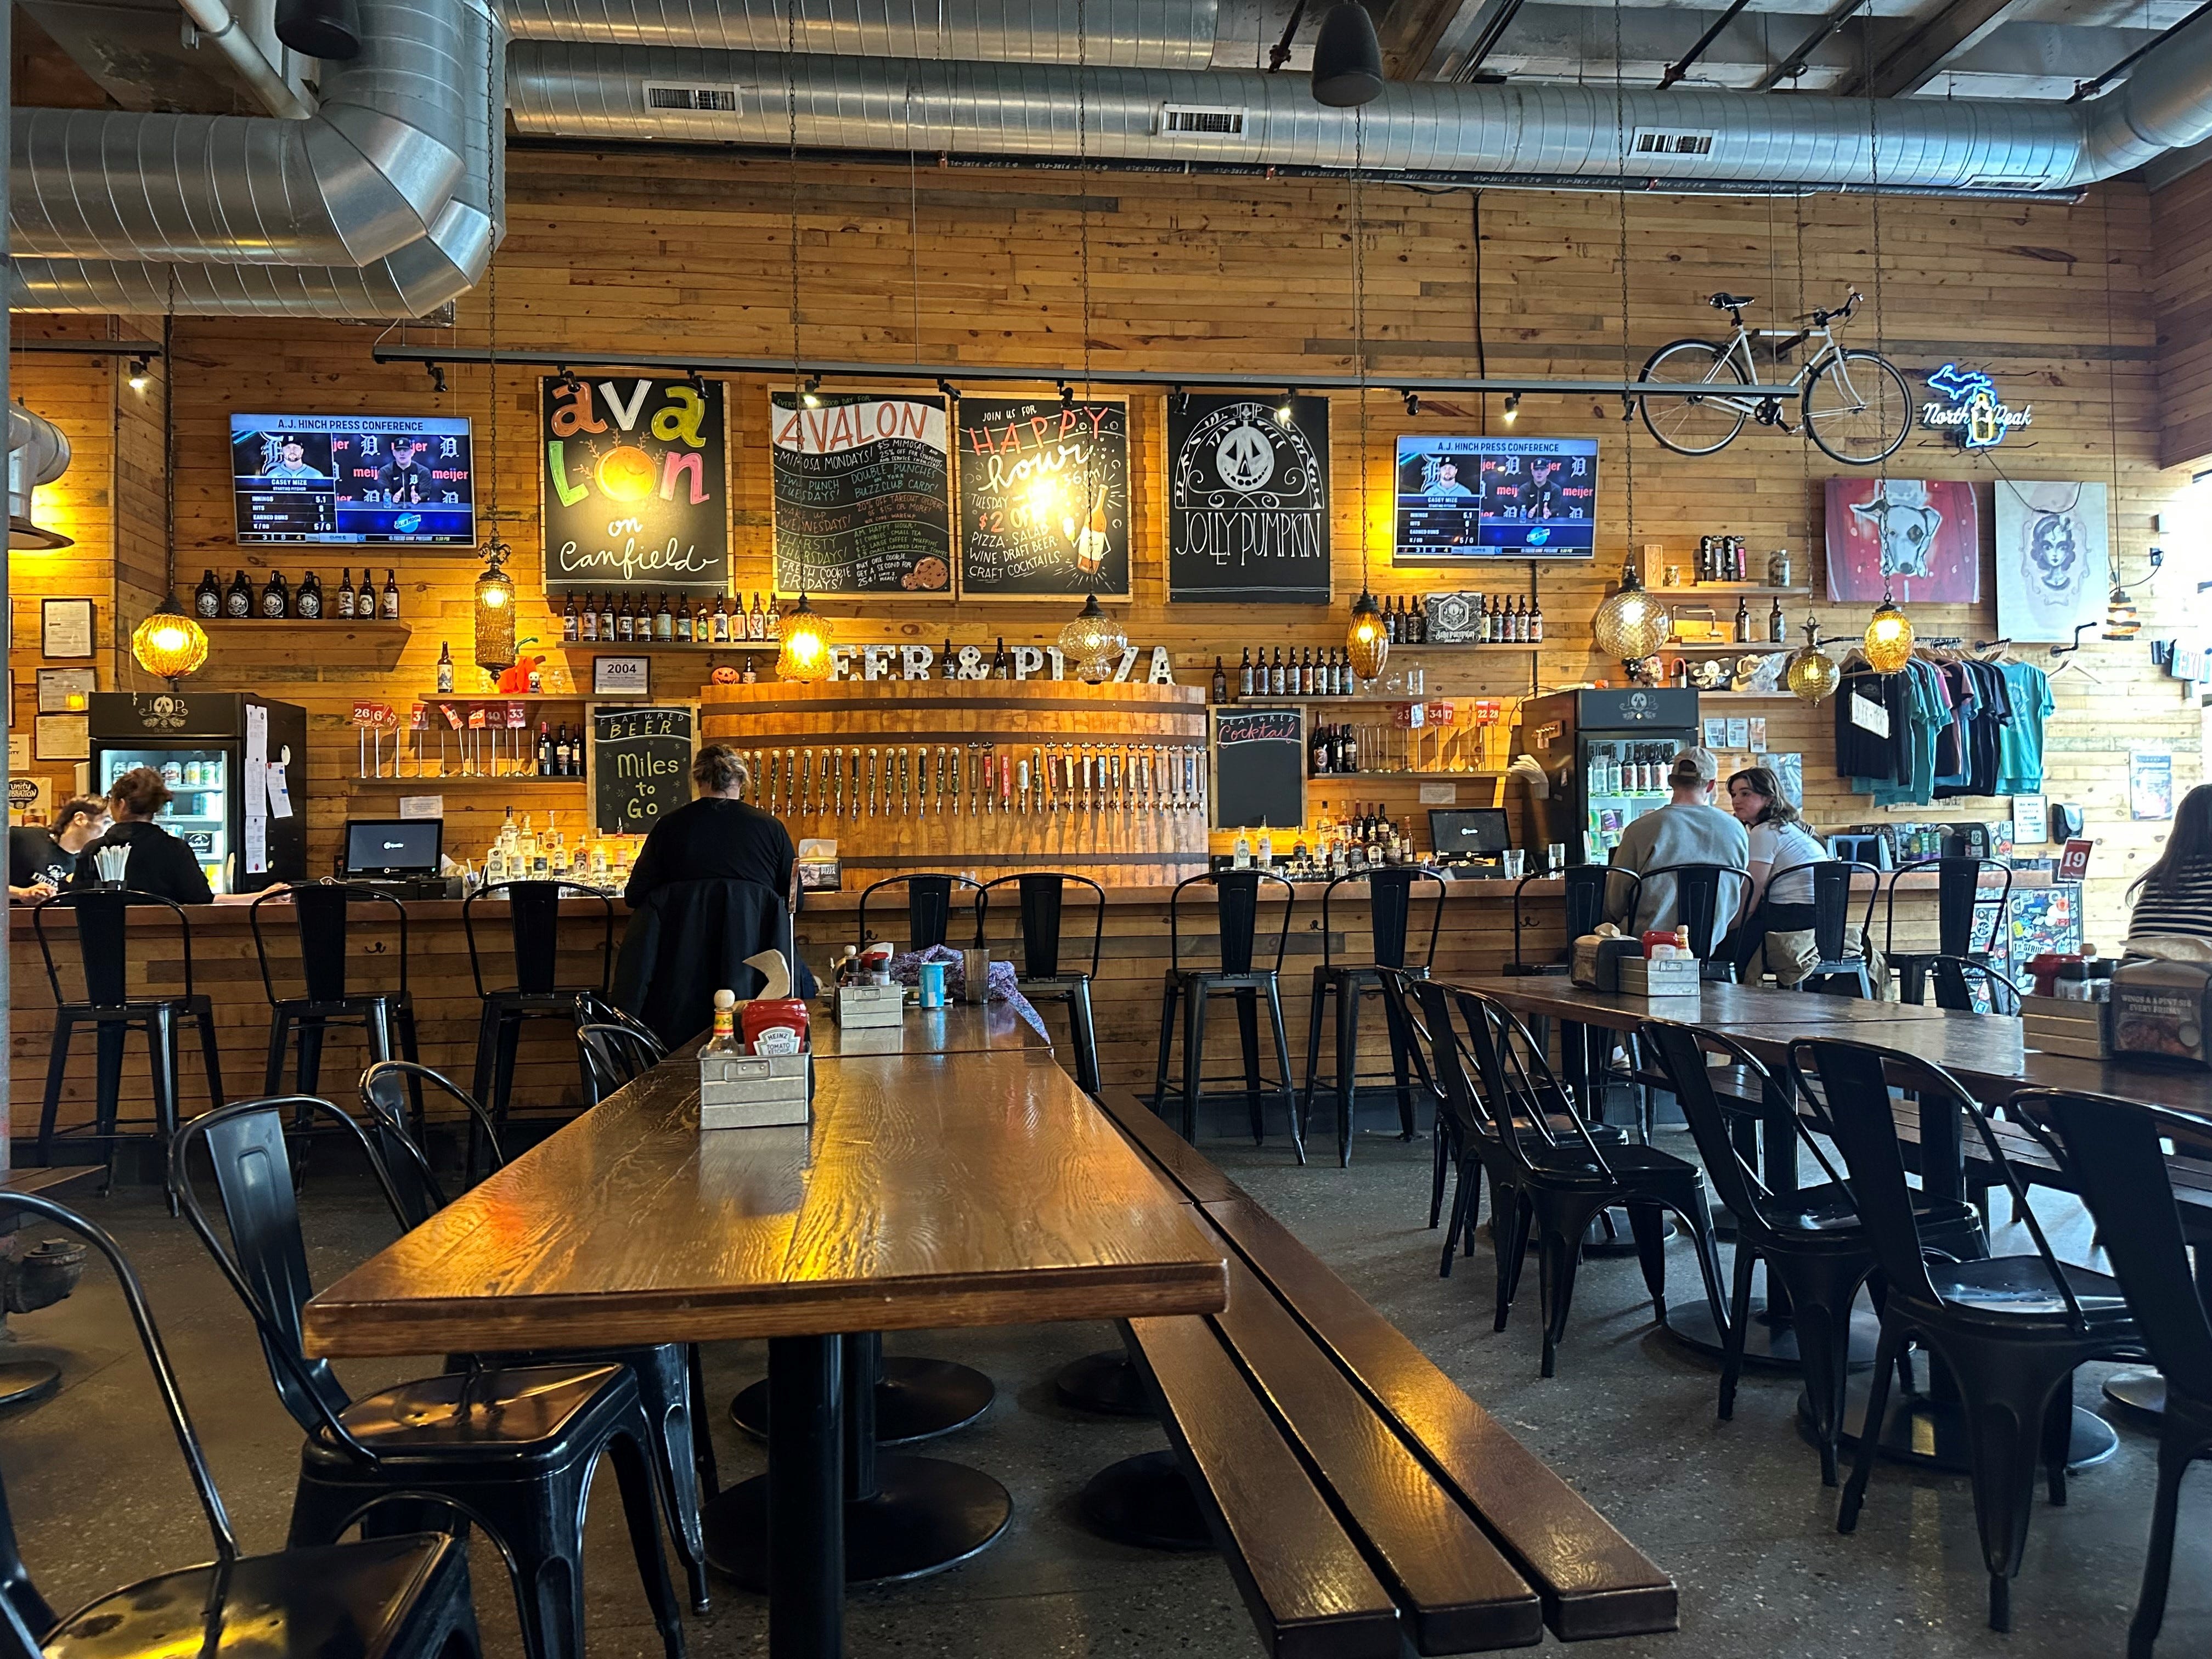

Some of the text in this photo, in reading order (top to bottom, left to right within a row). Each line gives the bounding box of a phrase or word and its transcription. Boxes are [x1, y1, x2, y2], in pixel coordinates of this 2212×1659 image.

[777, 399, 795, 408] EVERY
[983, 405, 1037, 422] JOIN US FOR
[1922, 402, 2032, 425] North Peak
[278, 419, 423, 431] A.J. HINCH PRESS CONFERENCE
[777, 402, 927, 453] AVALON
[969, 405, 1109, 456] HAPPY
[877, 439, 889, 450] $5
[892, 439, 927, 452] MIMOSAS
[879, 448, 895, 458] 25%
[1438, 442, 1559, 452] A.J. HINCH PRESS CONFERENCE
[825, 446, 873, 471] MONDAYS!
[432, 468, 469, 482] meijer
[851, 464, 937, 484] DOUBLE PUNCHES
[978, 443, 1094, 494] hour
[1084, 469, 1101, 479] PM
[781, 484, 839, 501] TUESDAYS!
[809, 479, 839, 491] PUNCH
[908, 479, 939, 493] CARDS!
[1563, 486, 1594, 499] meijer
[856, 494, 945, 512] 20% OFF TAKEOUT ORDERS
[880, 504, 892, 514] $15
[896, 503, 906, 511] OR
[970, 493, 1009, 509] TUESDAY
[608, 517, 643, 537] on
[978, 511, 1005, 533] $2
[854, 529, 866, 538] AM
[868, 524, 890, 533] HAPPY
[864, 532, 886, 542] COOKIES
[971, 522, 1051, 549] PIZZA SALAD
[1175, 511, 1321, 566] JOLLY PUMPKIN
[780, 532, 837, 550] THIRSTY
[870, 540, 887, 549] LARGE
[912, 538, 939, 548] MUFFINS
[969, 535, 1057, 564] WINE DRAFT BEER
[560, 537, 719, 579] Canfield
[856, 561, 868, 569] BUY
[969, 550, 1060, 579] CRAFT COCKTAILS
[782, 561, 851, 580] FRESH COOKIE
[856, 569, 867, 578] GET
[877, 562, 900, 571] SECOND
[781, 572, 843, 590] FRIDAYS!
[607, 664, 636, 673] 2004
[957, 645, 990, 681] &
[175, 699, 184, 712] P
[509, 709, 524, 718] 33
[1478, 709, 1498, 718] 22 28
[354, 708, 396, 726] 26 23
[413, 710, 426, 721] 31
[600, 713, 684, 727] FEATURED
[1221, 715, 1294, 726] FEATURED
[1429, 709, 1452, 720] 34 17
[610, 720, 671, 739] BEER
[1218, 722, 1295, 749] Cocktail
[617, 751, 679, 778] Miles
[635, 781, 656, 797] to
[627, 798, 658, 819] Go
[2063, 851, 2086, 868] 19
